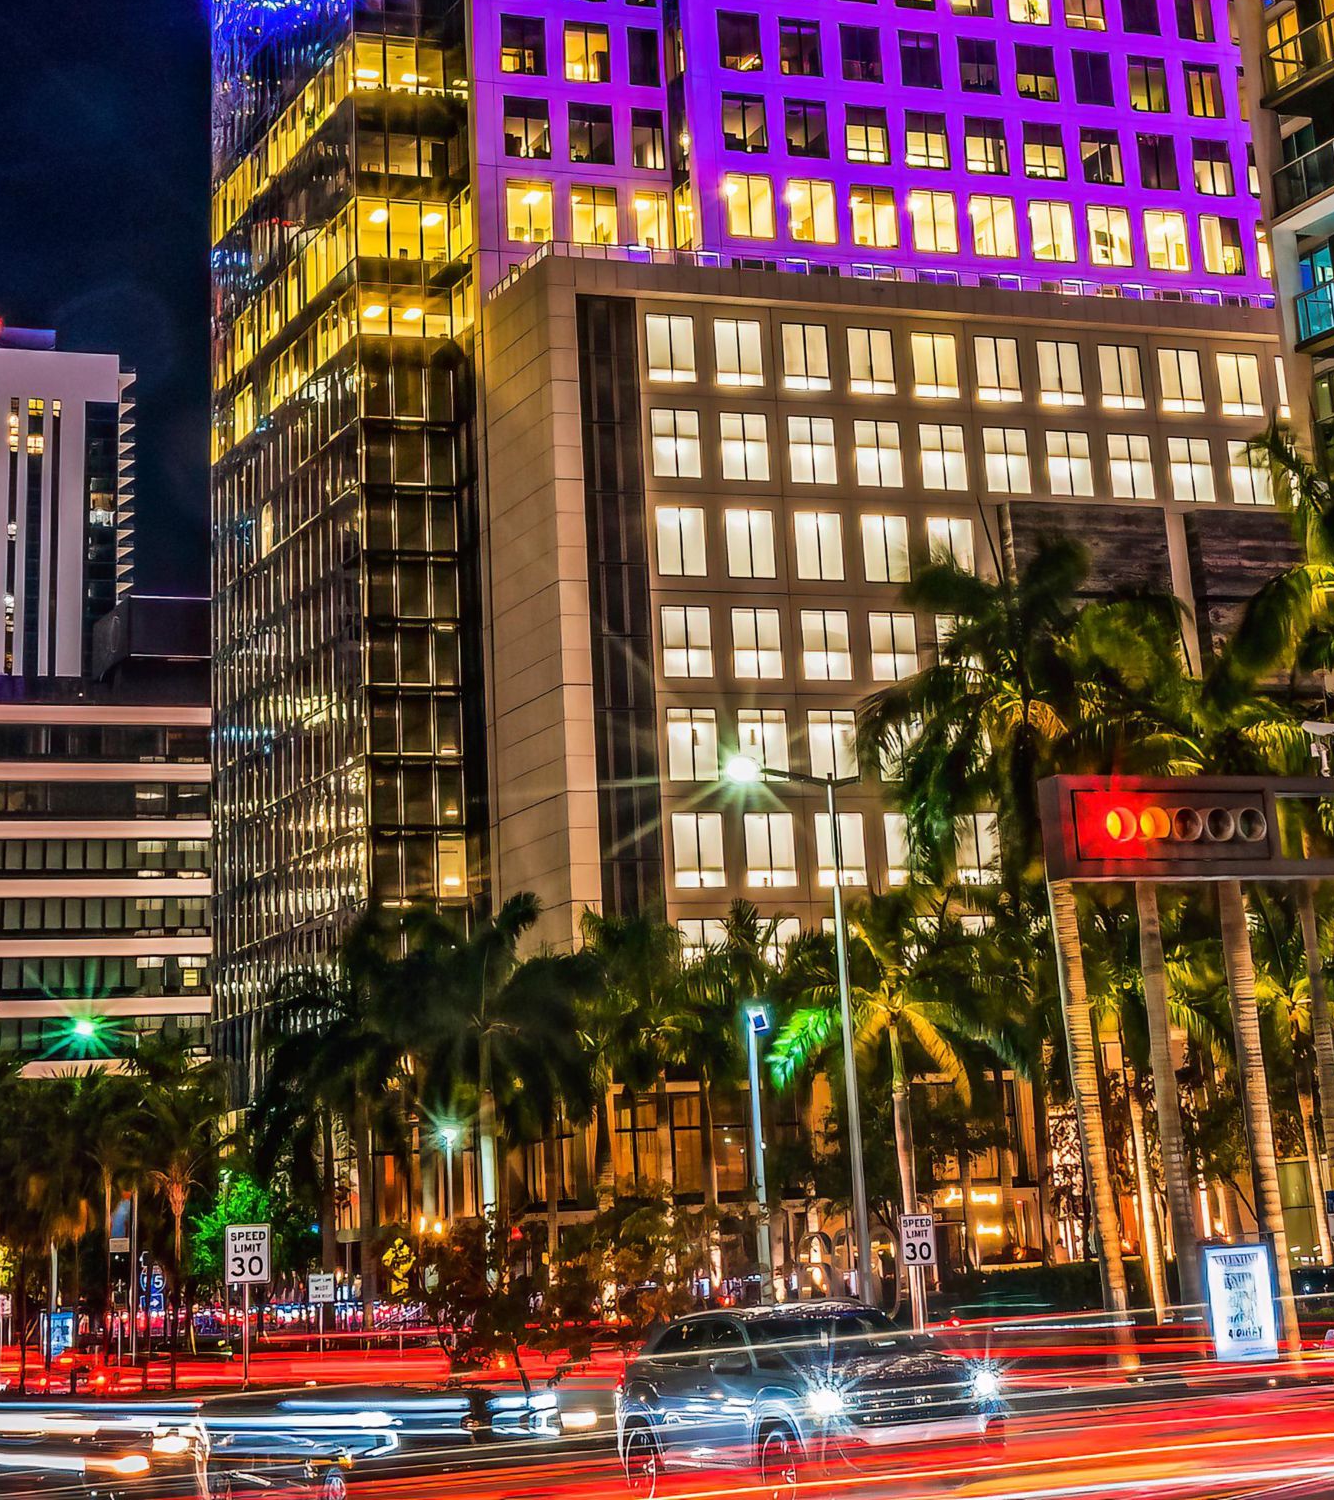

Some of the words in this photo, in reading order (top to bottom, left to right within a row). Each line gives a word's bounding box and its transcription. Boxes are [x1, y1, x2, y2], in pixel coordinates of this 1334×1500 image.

[903, 1218, 931, 1228] SPEED
[230, 1231, 266, 1242] SPEED
[907, 1229, 928, 1238] LIMIT
[234, 1243, 262, 1253] LIMIT
[906, 1242, 931, 1260] 30
[231, 1255, 263, 1276] 30
